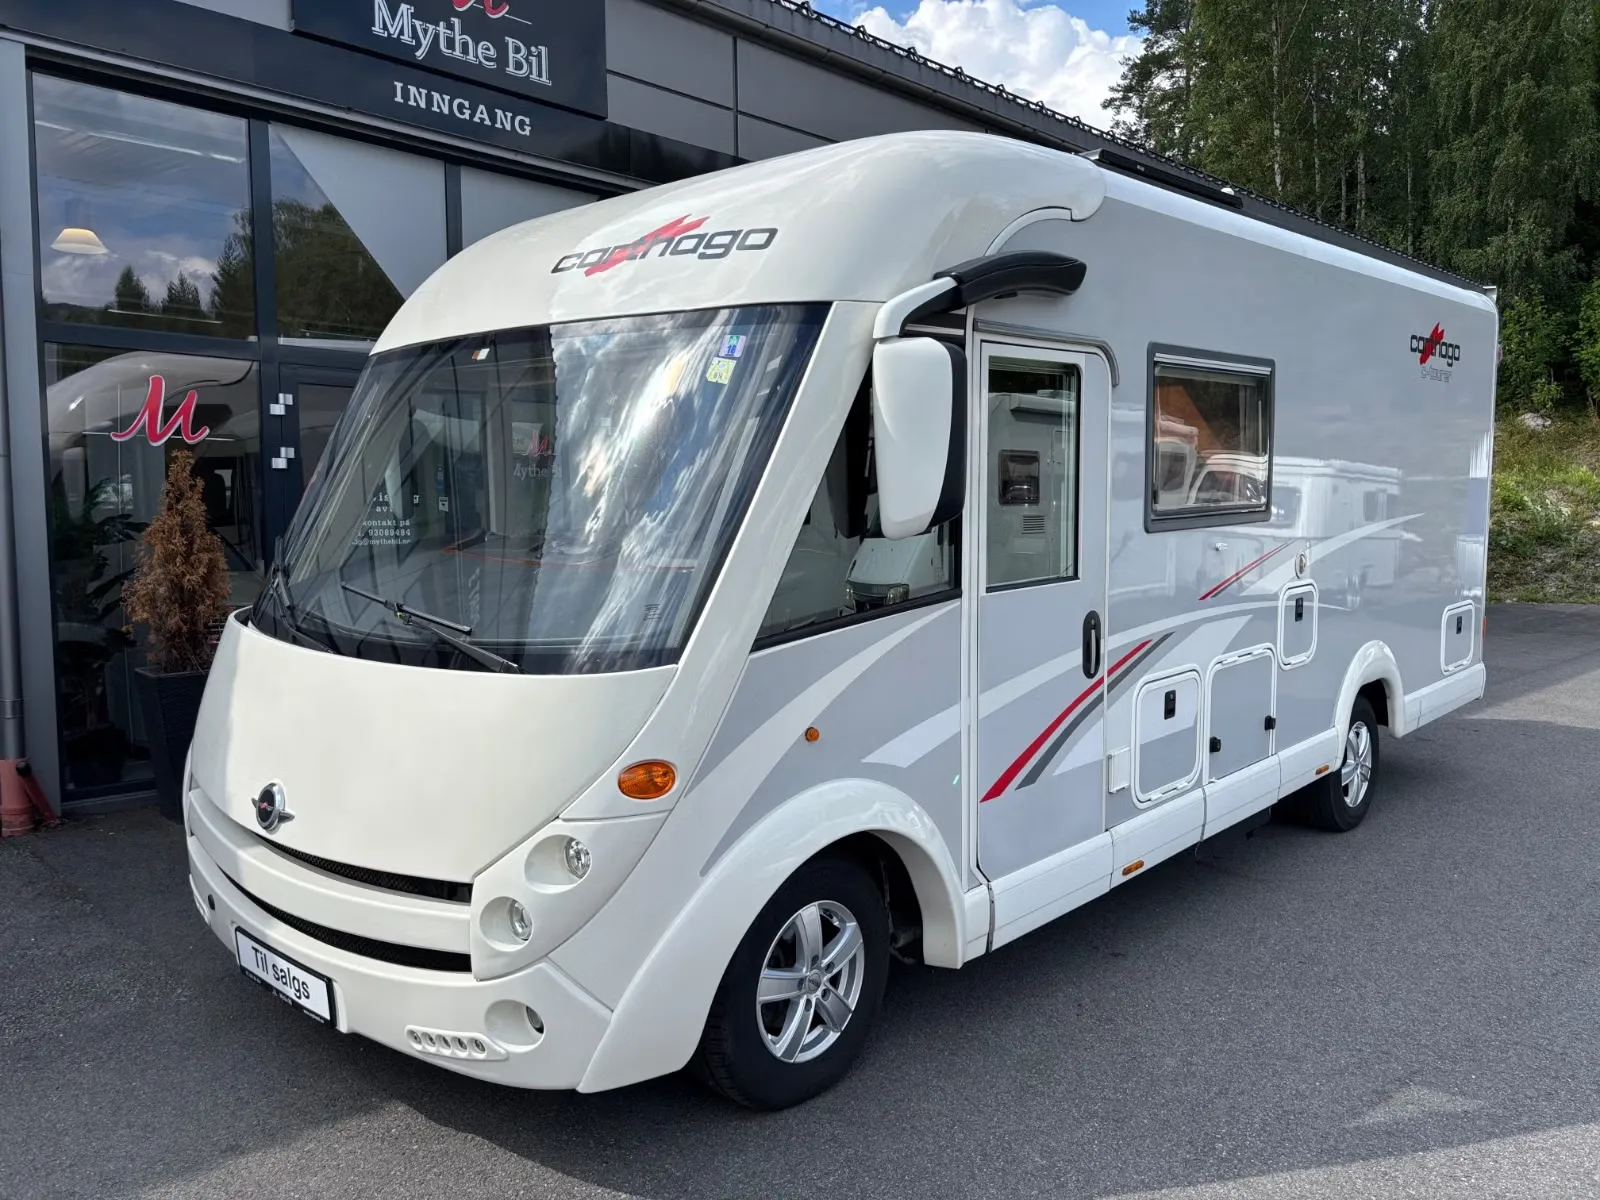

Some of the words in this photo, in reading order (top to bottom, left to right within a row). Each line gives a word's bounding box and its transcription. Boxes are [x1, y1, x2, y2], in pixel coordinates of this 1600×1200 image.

[371, 0, 497, 69] Mythe
[504, 36, 552, 86] Bil
[394, 81, 532, 136] INNGANG
[551, 228, 778, 274] carthago
[251, 946, 269, 975] Til
[272, 963, 311, 1000] salgs
